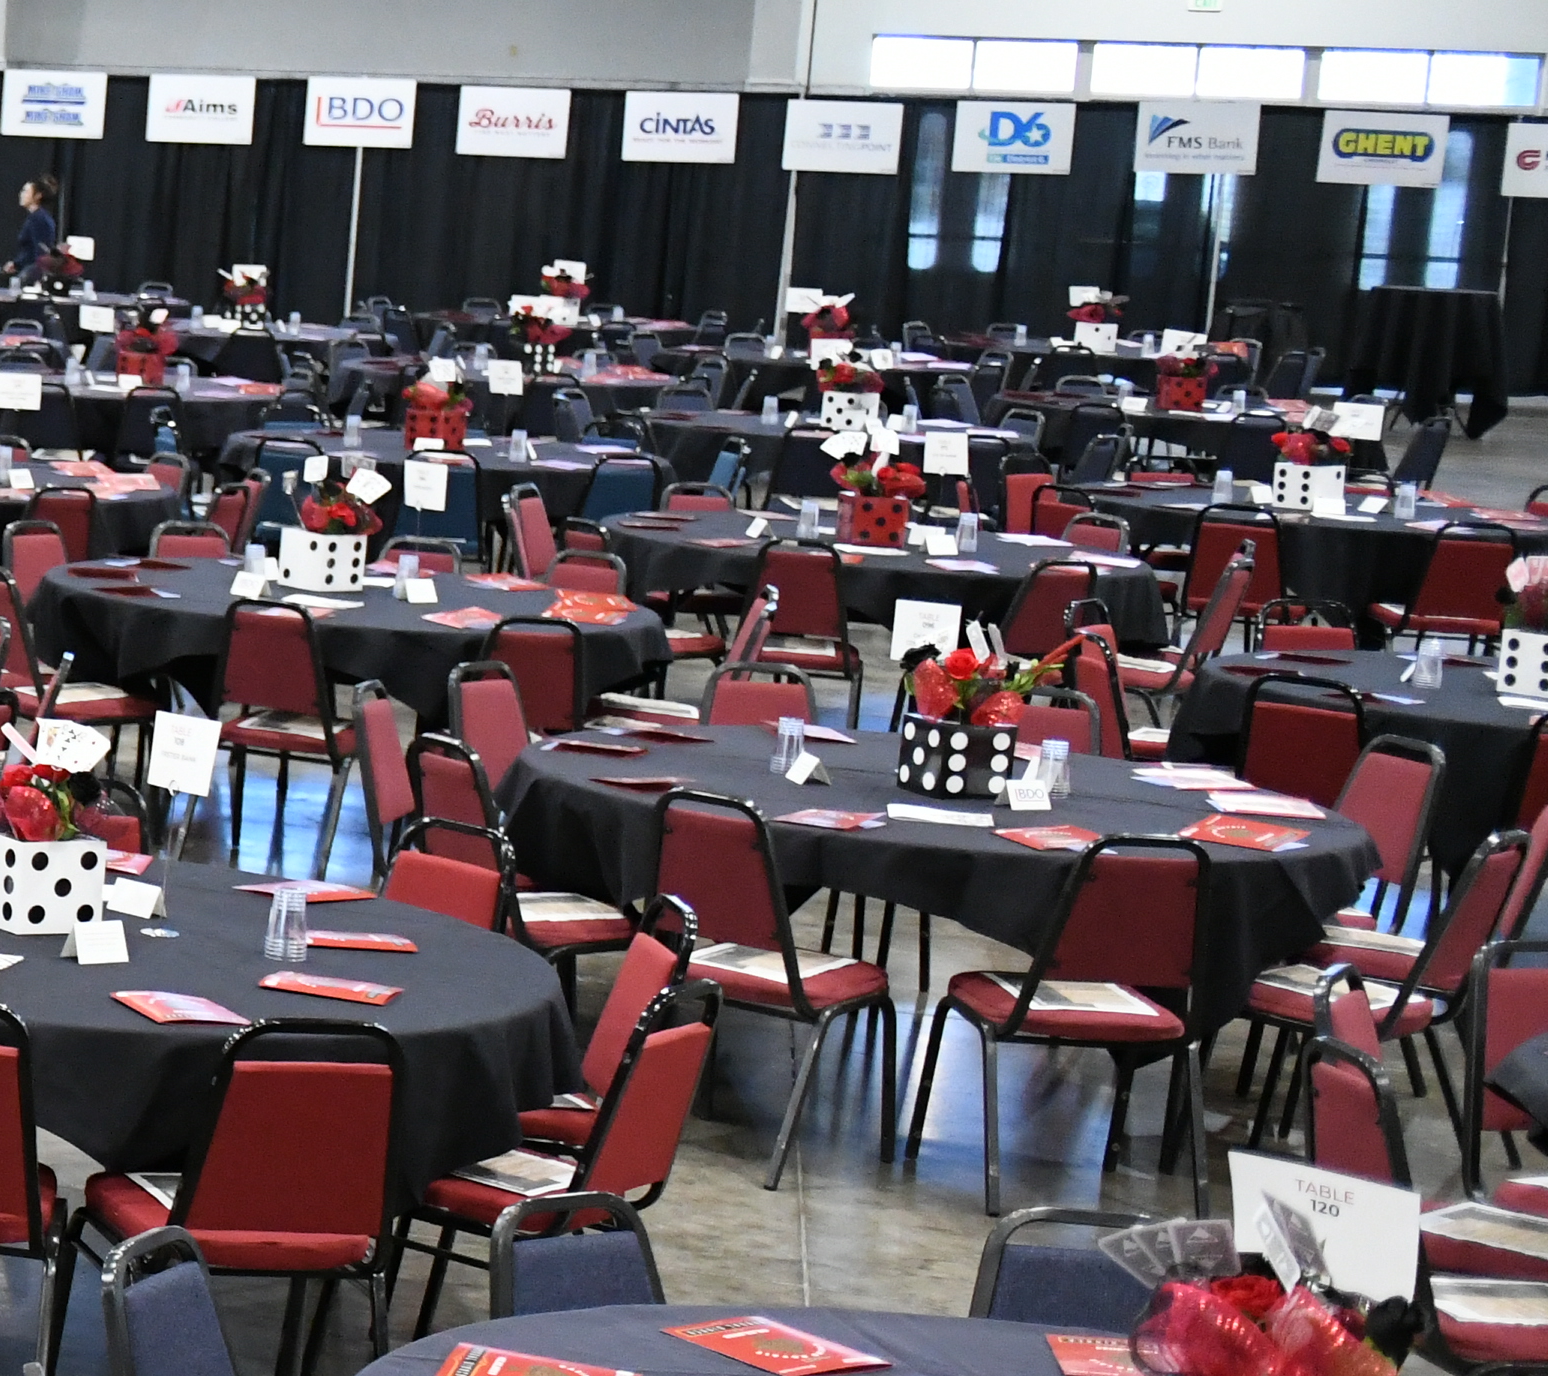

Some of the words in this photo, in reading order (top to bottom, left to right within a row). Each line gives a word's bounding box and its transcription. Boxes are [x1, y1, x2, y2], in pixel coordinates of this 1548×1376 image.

[183, 98, 238, 115] Aims
[327, 97, 404, 121] BDO
[468, 108, 554, 130] Burris
[989, 111, 1052, 148] D6
[1167, 136, 1203, 149] FMS
[1209, 137, 1244, 150] Bank
[1339, 132, 1429, 156] GHENT
[1019, 789, 1045, 800] BDO
[1295, 1177, 1356, 1206] TABLE
[1309, 1198, 1341, 1219] 120
